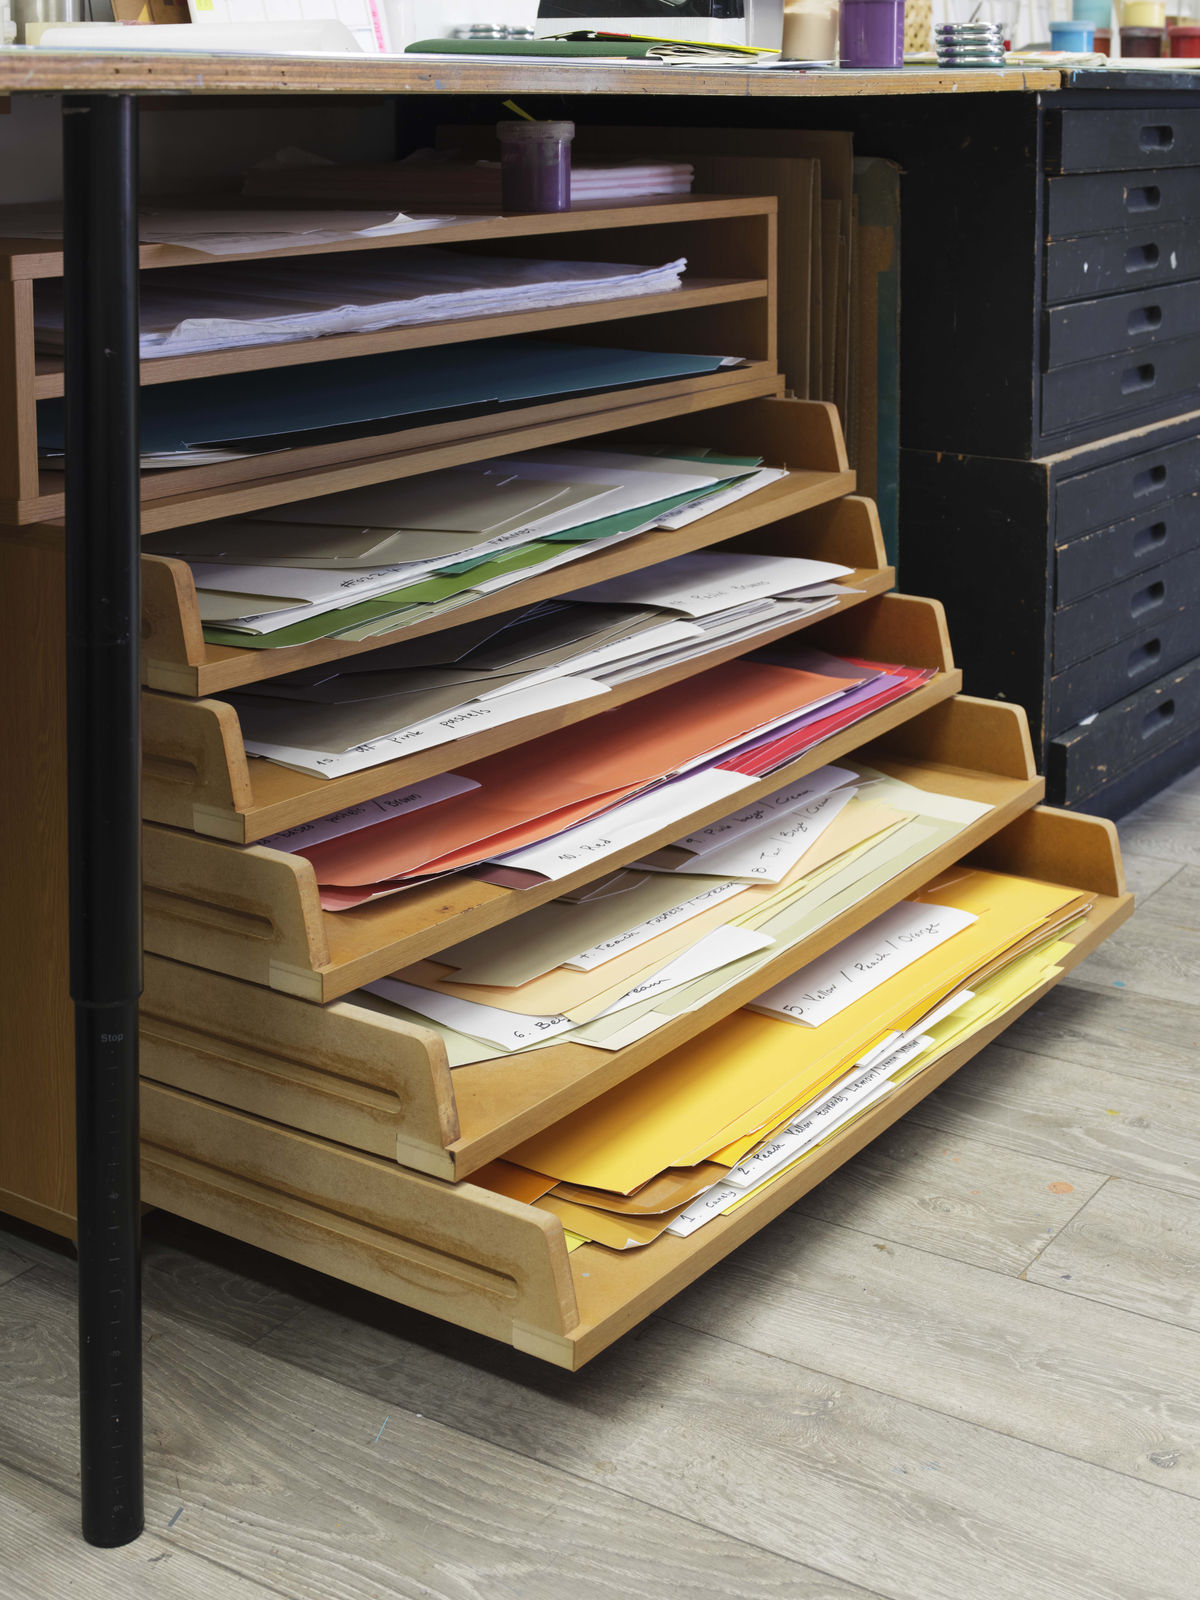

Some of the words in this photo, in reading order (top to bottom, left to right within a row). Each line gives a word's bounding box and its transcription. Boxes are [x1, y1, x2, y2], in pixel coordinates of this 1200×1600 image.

[439, 707, 491, 729] pastels
[383, 793, 422, 808] Brown
[579, 838, 611, 851] Red
[783, 1004, 811, 1016] 5.
[802, 984, 837, 1002] Yellow
[840, 970, 853, 983] /
[854, 951, 891, 972] Peach
[884, 939, 899, 950] /
[898, 921, 940, 943] Orange
[100, 1033, 124, 1043] Stop
[513, 1030, 532, 1039] 6.
[753, 1143, 786, 1162] Peach
[784, 1120, 813, 1136] Yellow
[815, 1094, 849, 1116] towards
